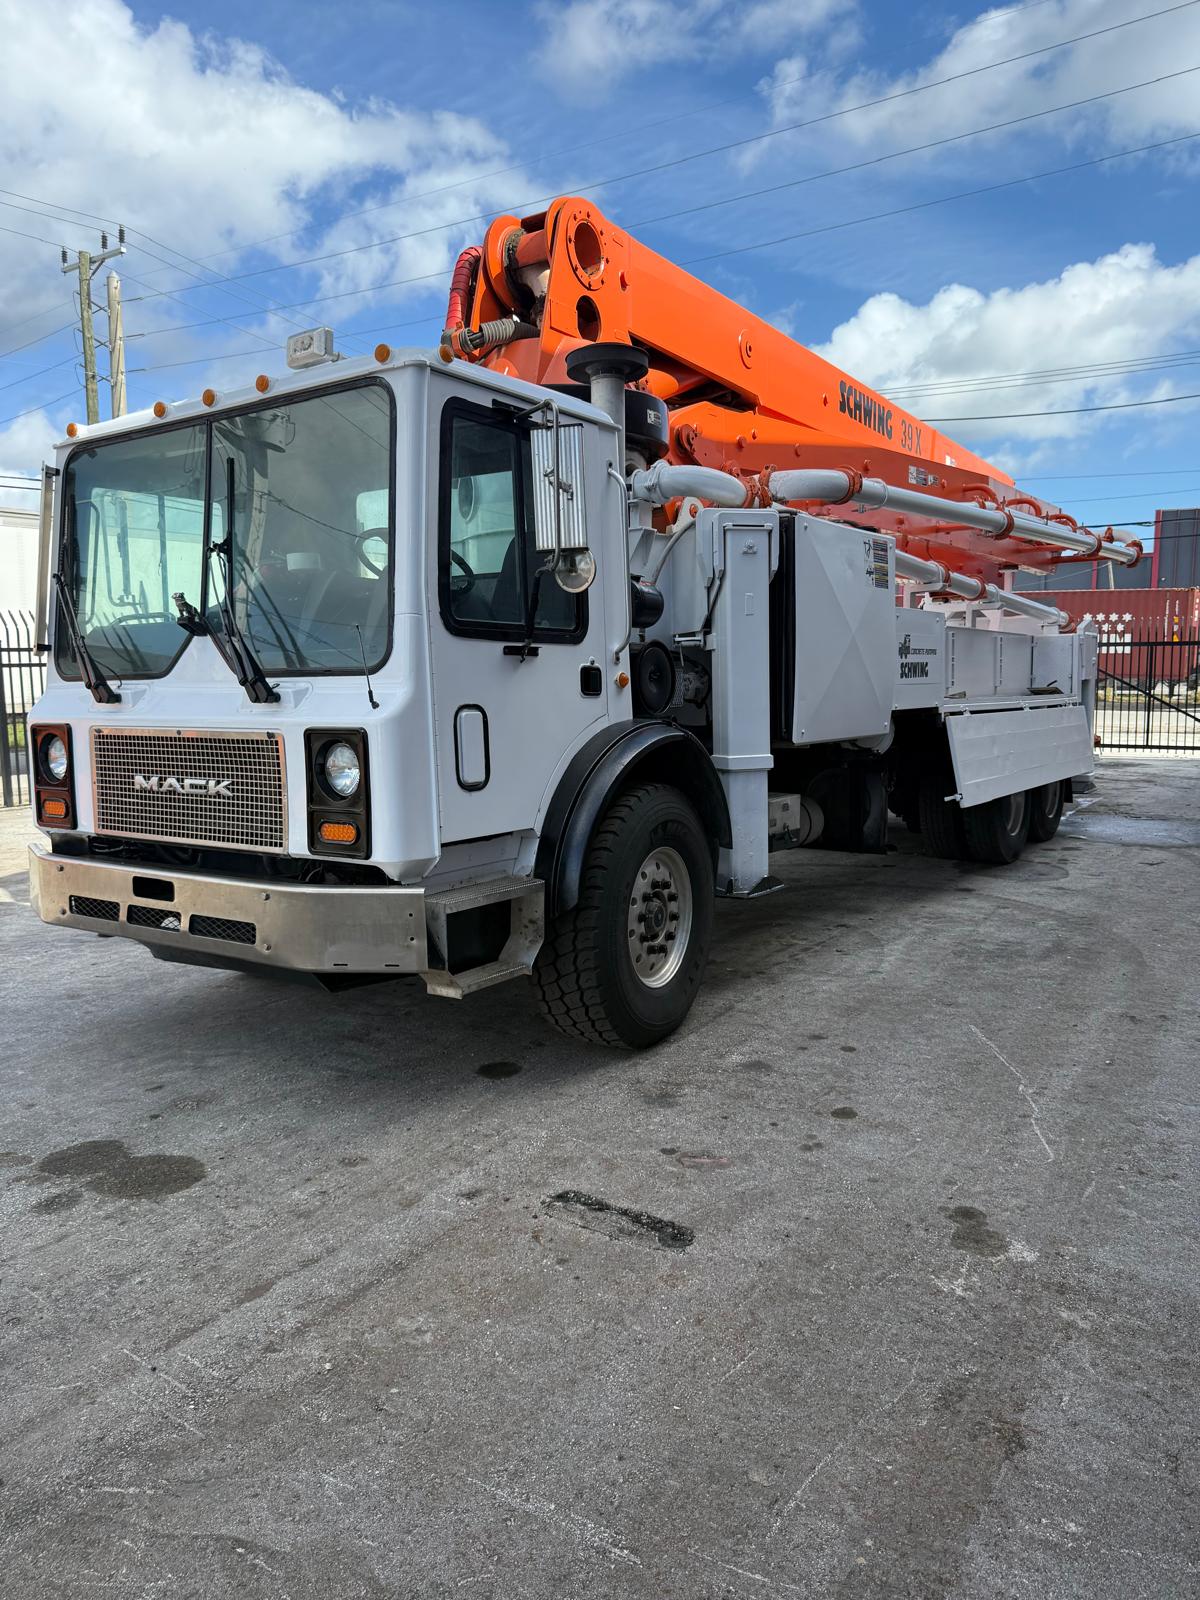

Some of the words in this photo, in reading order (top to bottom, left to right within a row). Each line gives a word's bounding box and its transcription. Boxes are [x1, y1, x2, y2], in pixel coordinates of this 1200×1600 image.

[839, 380, 893, 440] SCHWING
[901, 418, 912, 452] 39
[1096, 632, 1132, 655] IM
[900, 661, 928, 679] SCHWING
[134, 775, 233, 797] MACK
